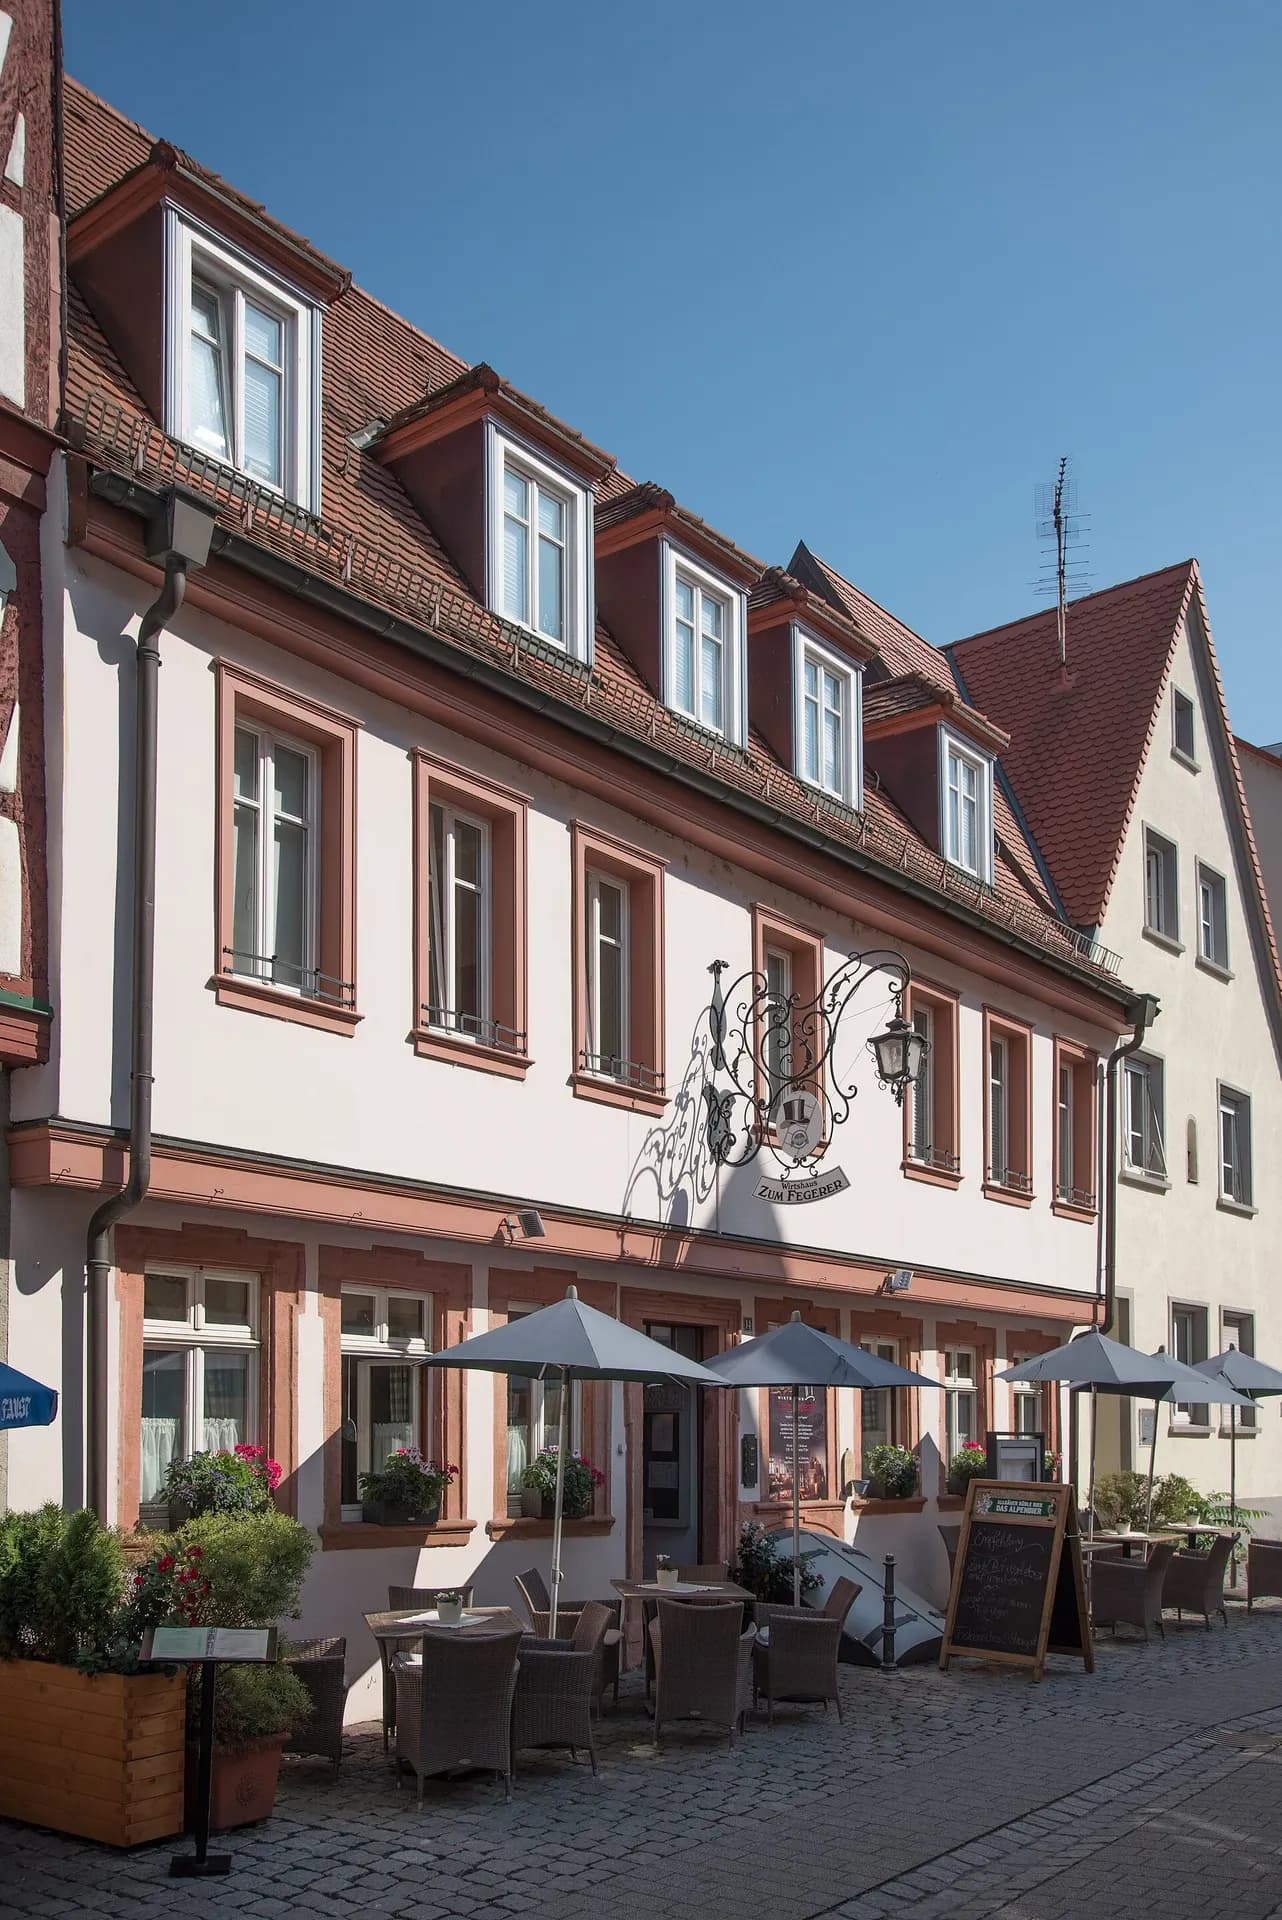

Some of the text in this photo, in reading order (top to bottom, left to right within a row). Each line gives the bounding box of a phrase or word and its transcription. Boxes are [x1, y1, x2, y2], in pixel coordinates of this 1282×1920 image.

[758, 1180, 843, 1201] ZUM FEGERER
[781, 1181, 818, 1190] Wirtshaus
[995, 1504, 1042, 1515] DAS ALPENBIER
